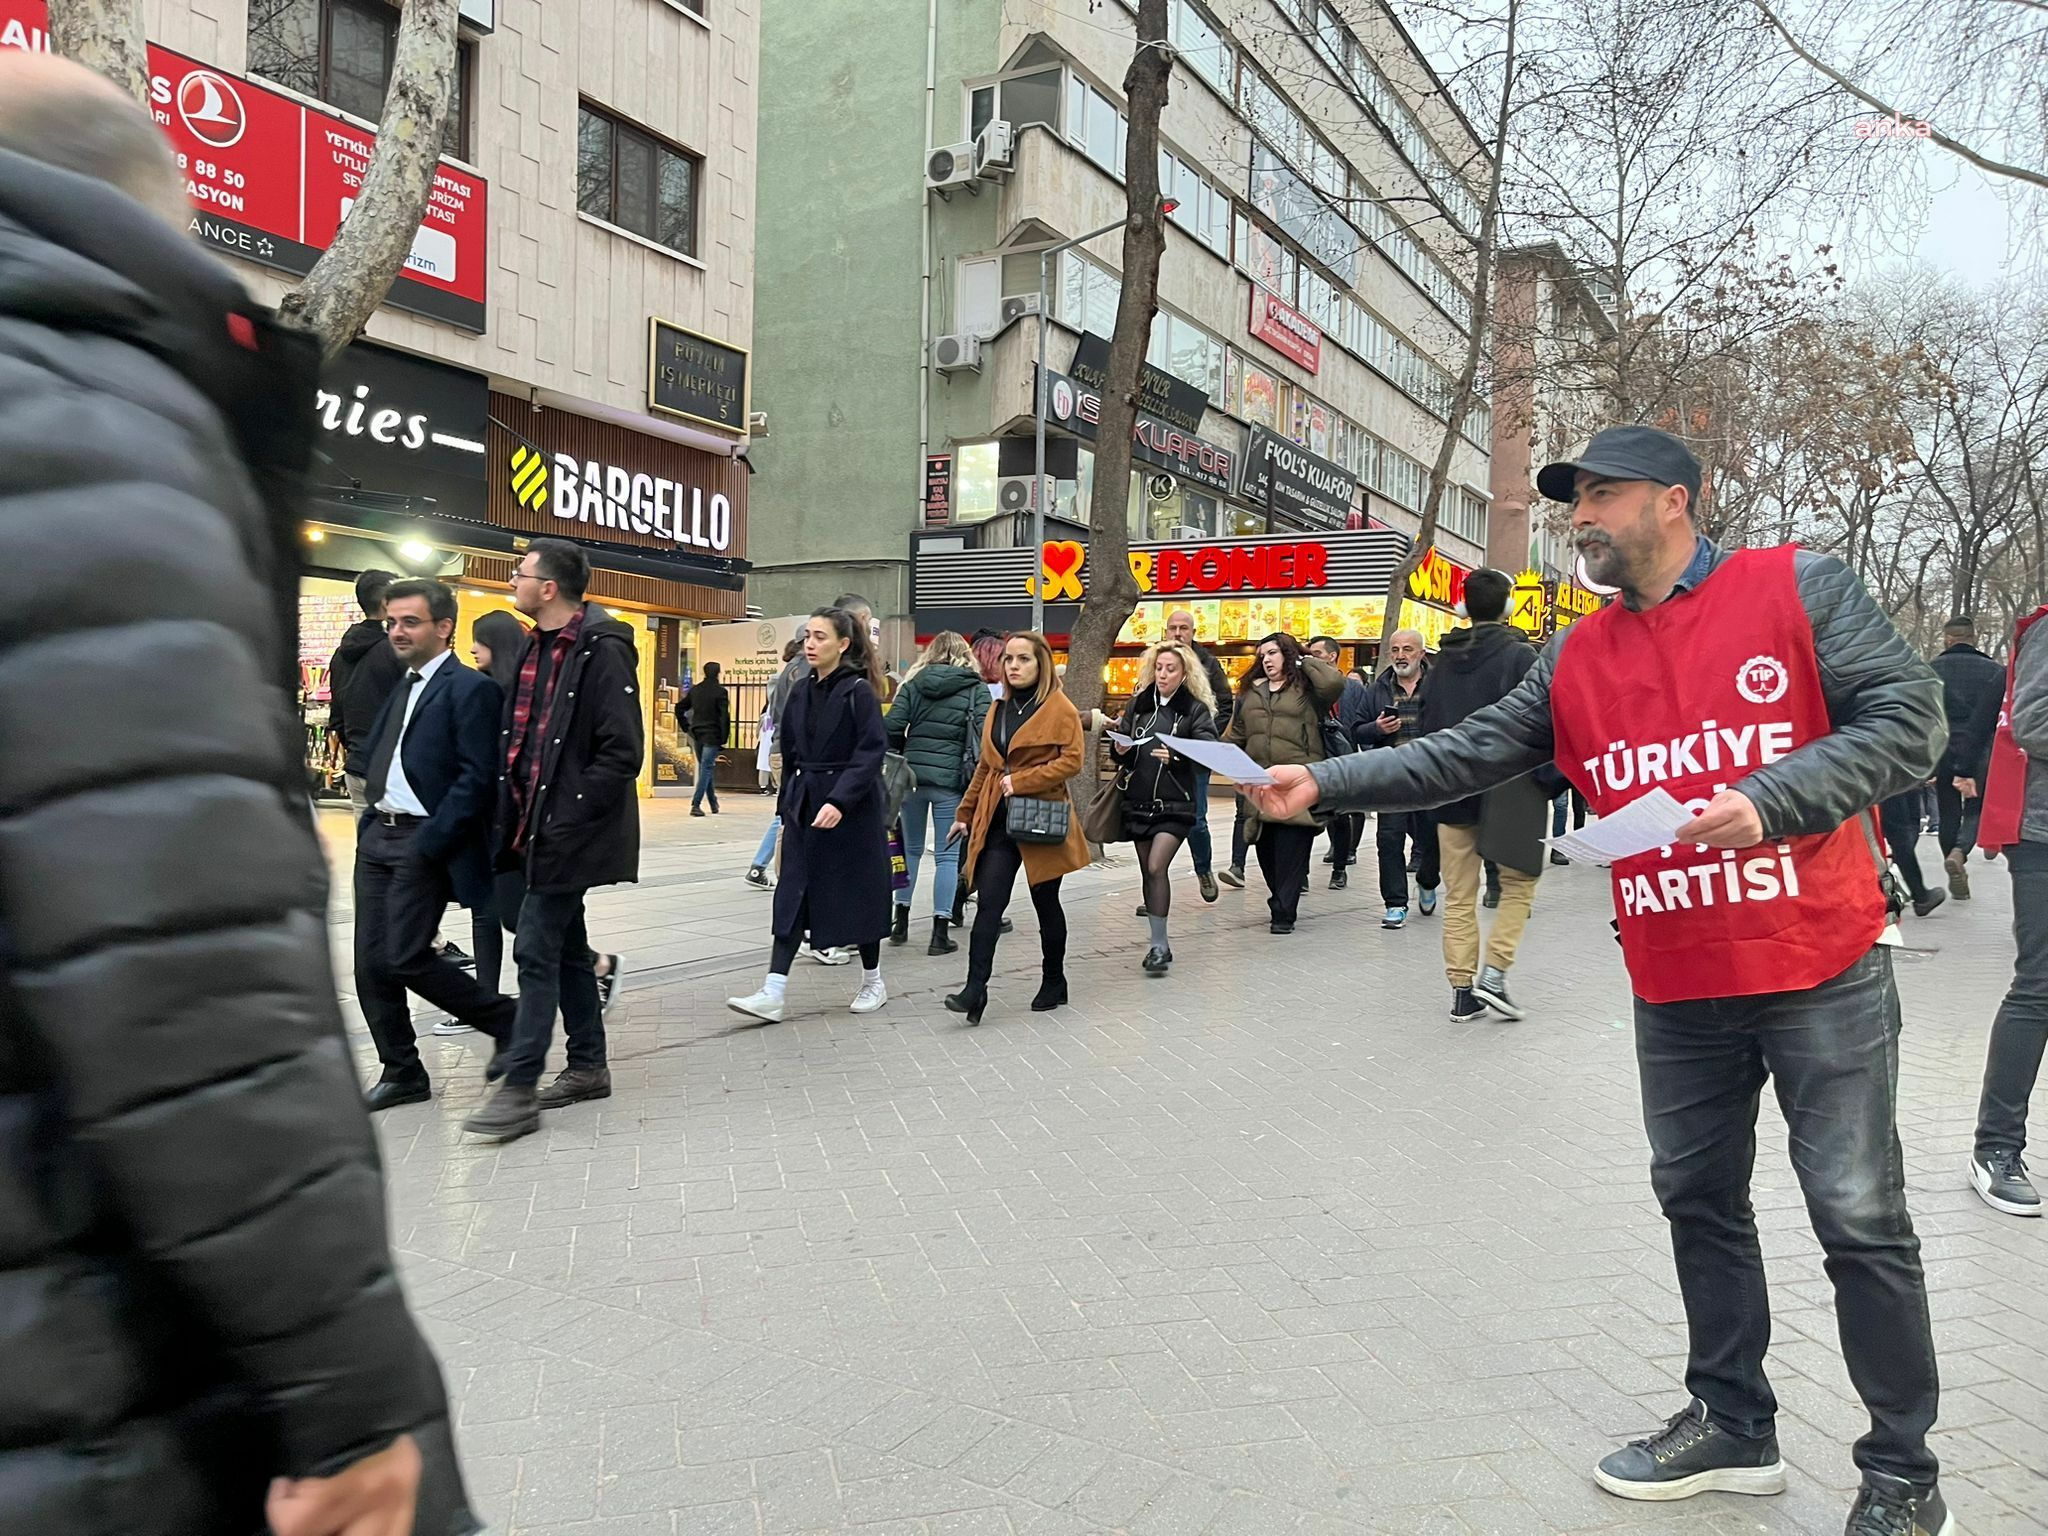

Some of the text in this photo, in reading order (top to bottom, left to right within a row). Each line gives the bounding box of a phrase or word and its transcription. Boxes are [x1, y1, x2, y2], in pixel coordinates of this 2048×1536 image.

[325, 130, 373, 159] YETKİL
[195, 159, 216, 180] 88
[223, 169, 245, 189] 50
[185, 179, 244, 212] ASYON
[188, 216, 252, 251] ANCE
[315, 385, 428, 449] ries
[720, 404, 728, 419] 5
[1133, 420, 1230, 480] KUAFÖR
[553, 452, 731, 551] BARGELLO
[1307, 464, 1353, 503] KUAFÖR
[1156, 542, 1329, 594] DÖNER
[1749, 666, 1775, 682] TİP
[1583, 719, 1793, 796] TÜRKİYE
[1619, 844, 1799, 917] PARTİSİ
